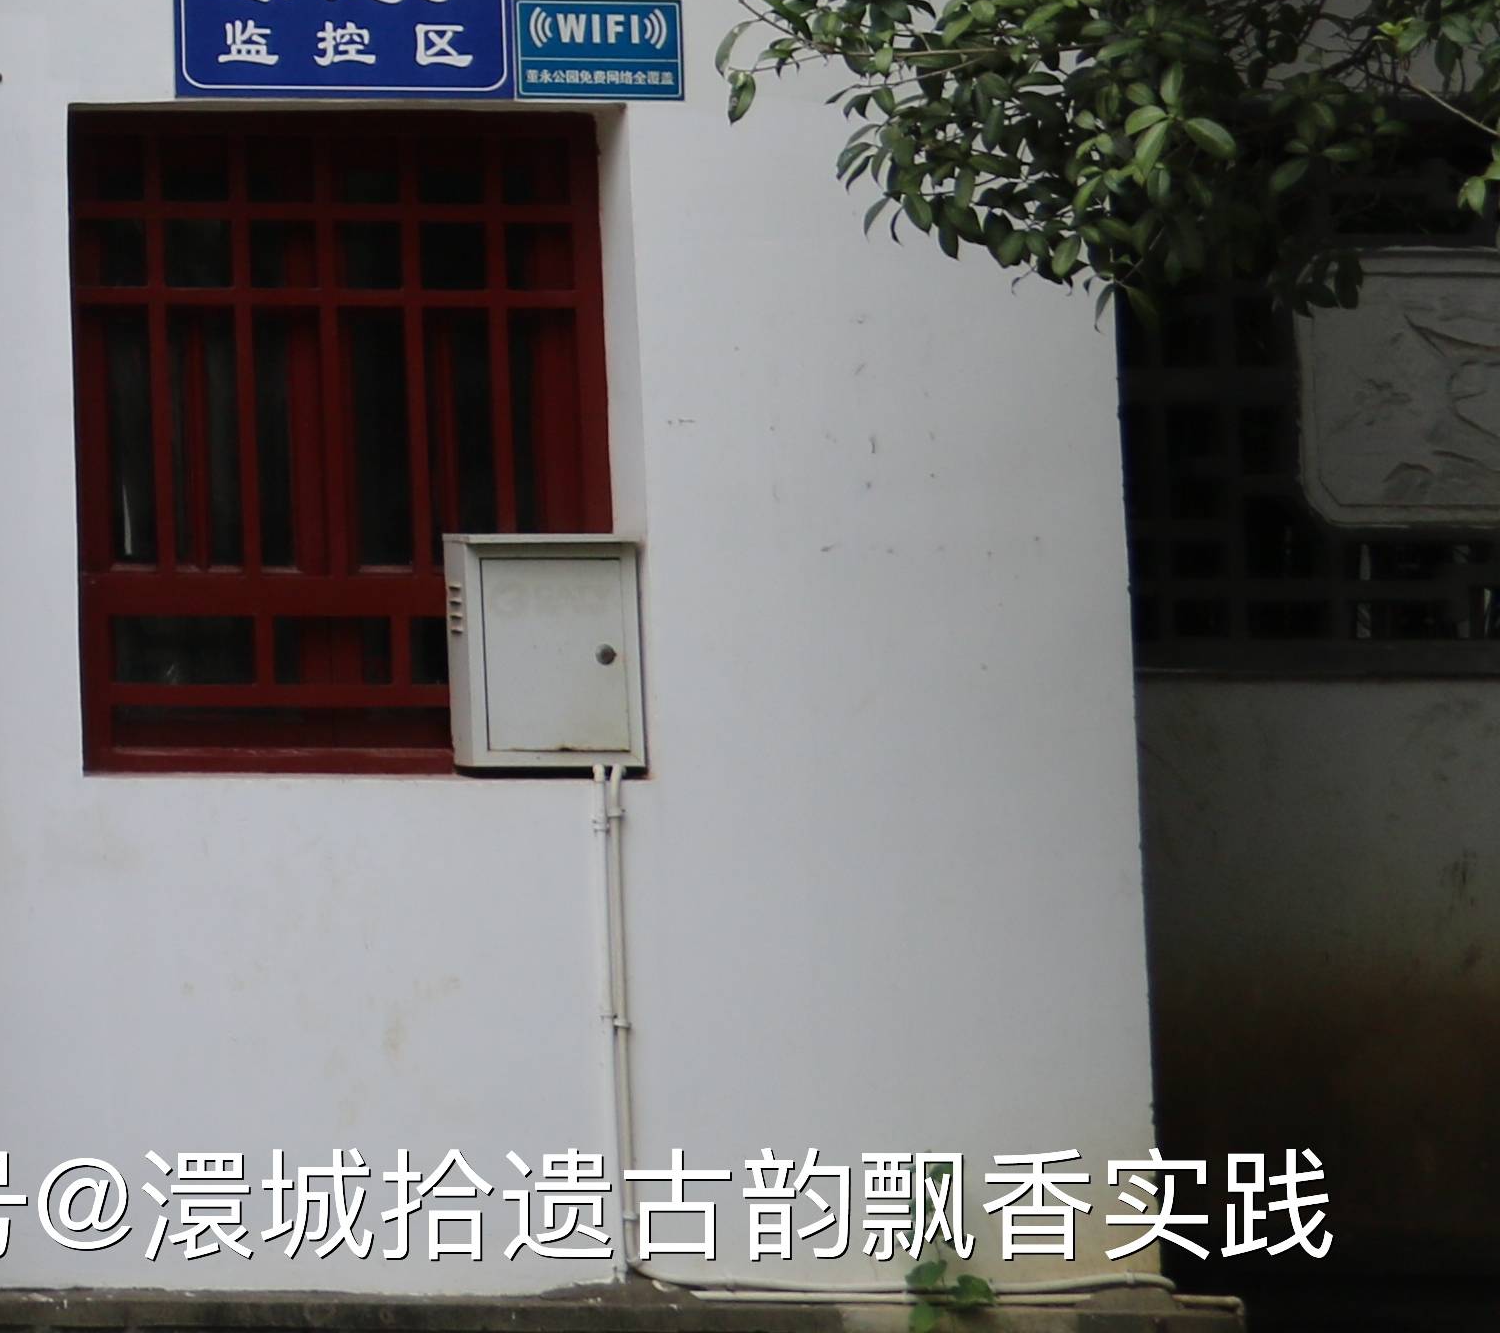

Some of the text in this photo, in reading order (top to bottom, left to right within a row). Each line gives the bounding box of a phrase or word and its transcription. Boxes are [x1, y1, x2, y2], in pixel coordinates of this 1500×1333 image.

[557, 13, 640, 43] WIFI
[218, 20, 473, 67] 监控区
[526, 69, 675, 86] 董永公园免费网络全覆盖
